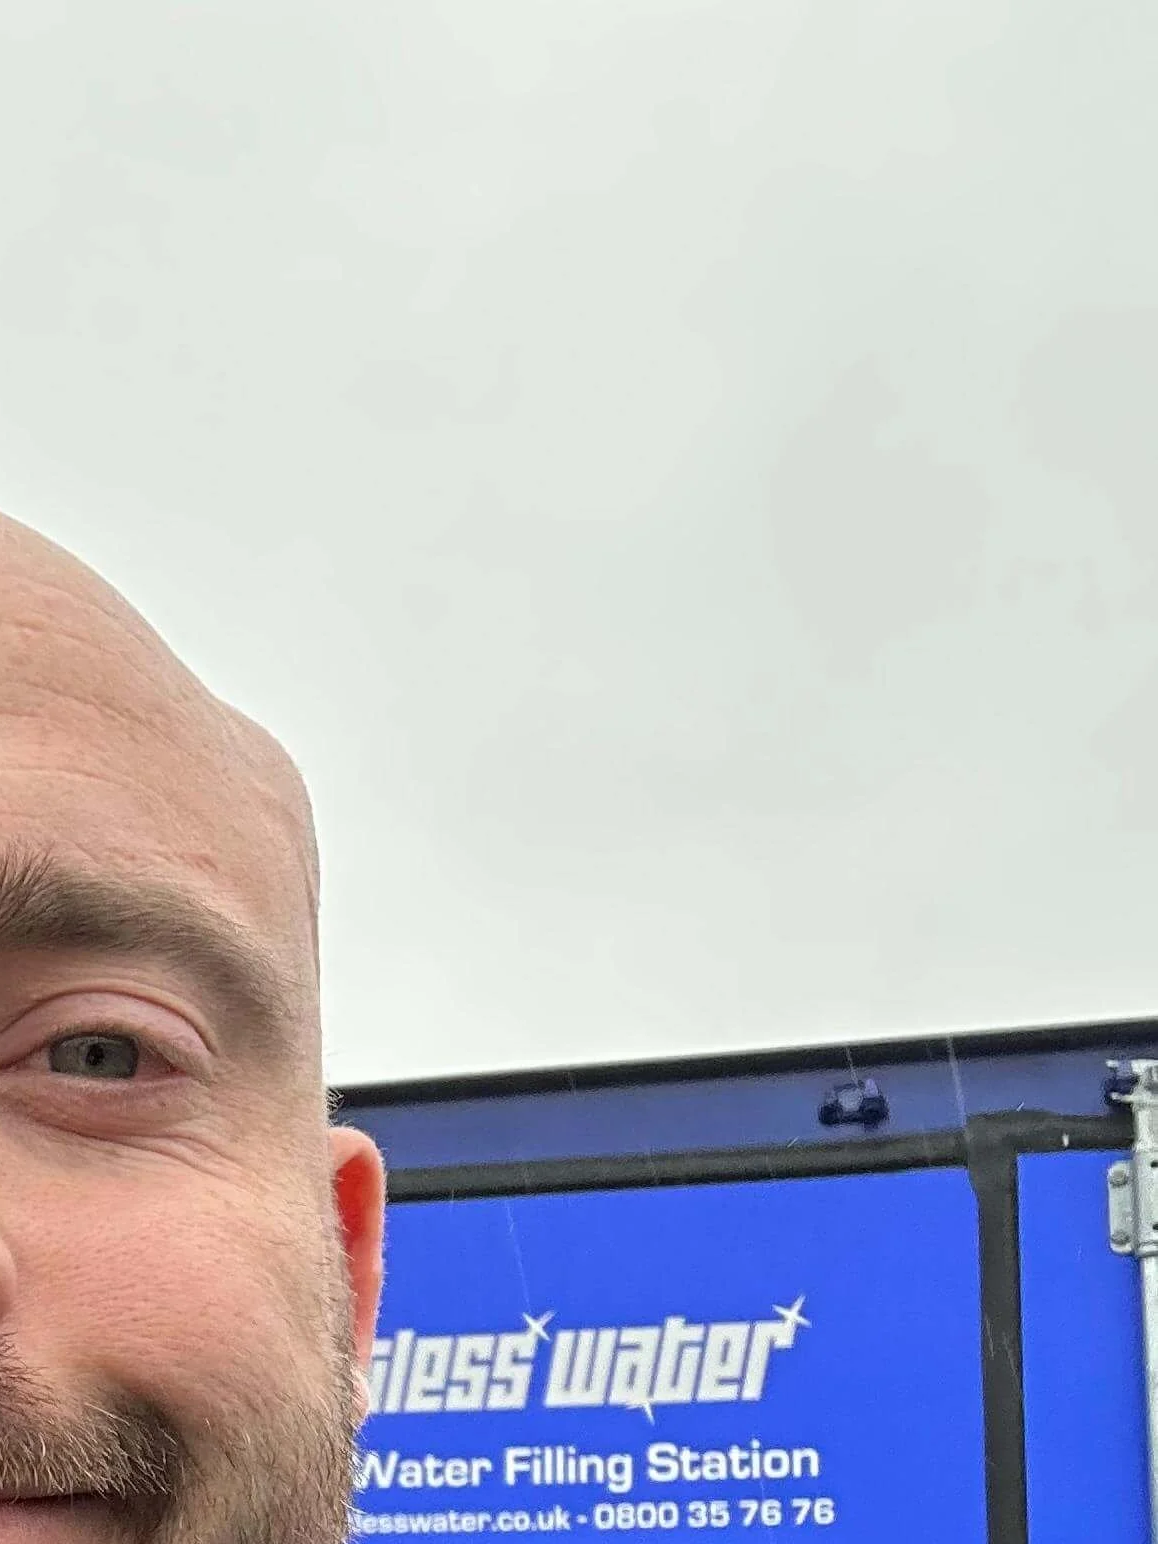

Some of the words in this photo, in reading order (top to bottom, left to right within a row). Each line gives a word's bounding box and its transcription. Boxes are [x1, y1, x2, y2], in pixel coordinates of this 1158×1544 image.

[544, 1315, 797, 1408] water
[353, 1450, 493, 1489] Water
[504, 1446, 633, 1494] Filling
[646, 1438, 820, 1482] Station
[594, 1501, 680, 1530] 0800
[687, 1499, 731, 1529] 35
[738, 1498, 783, 1527] 76
[791, 1496, 836, 1526] 76
